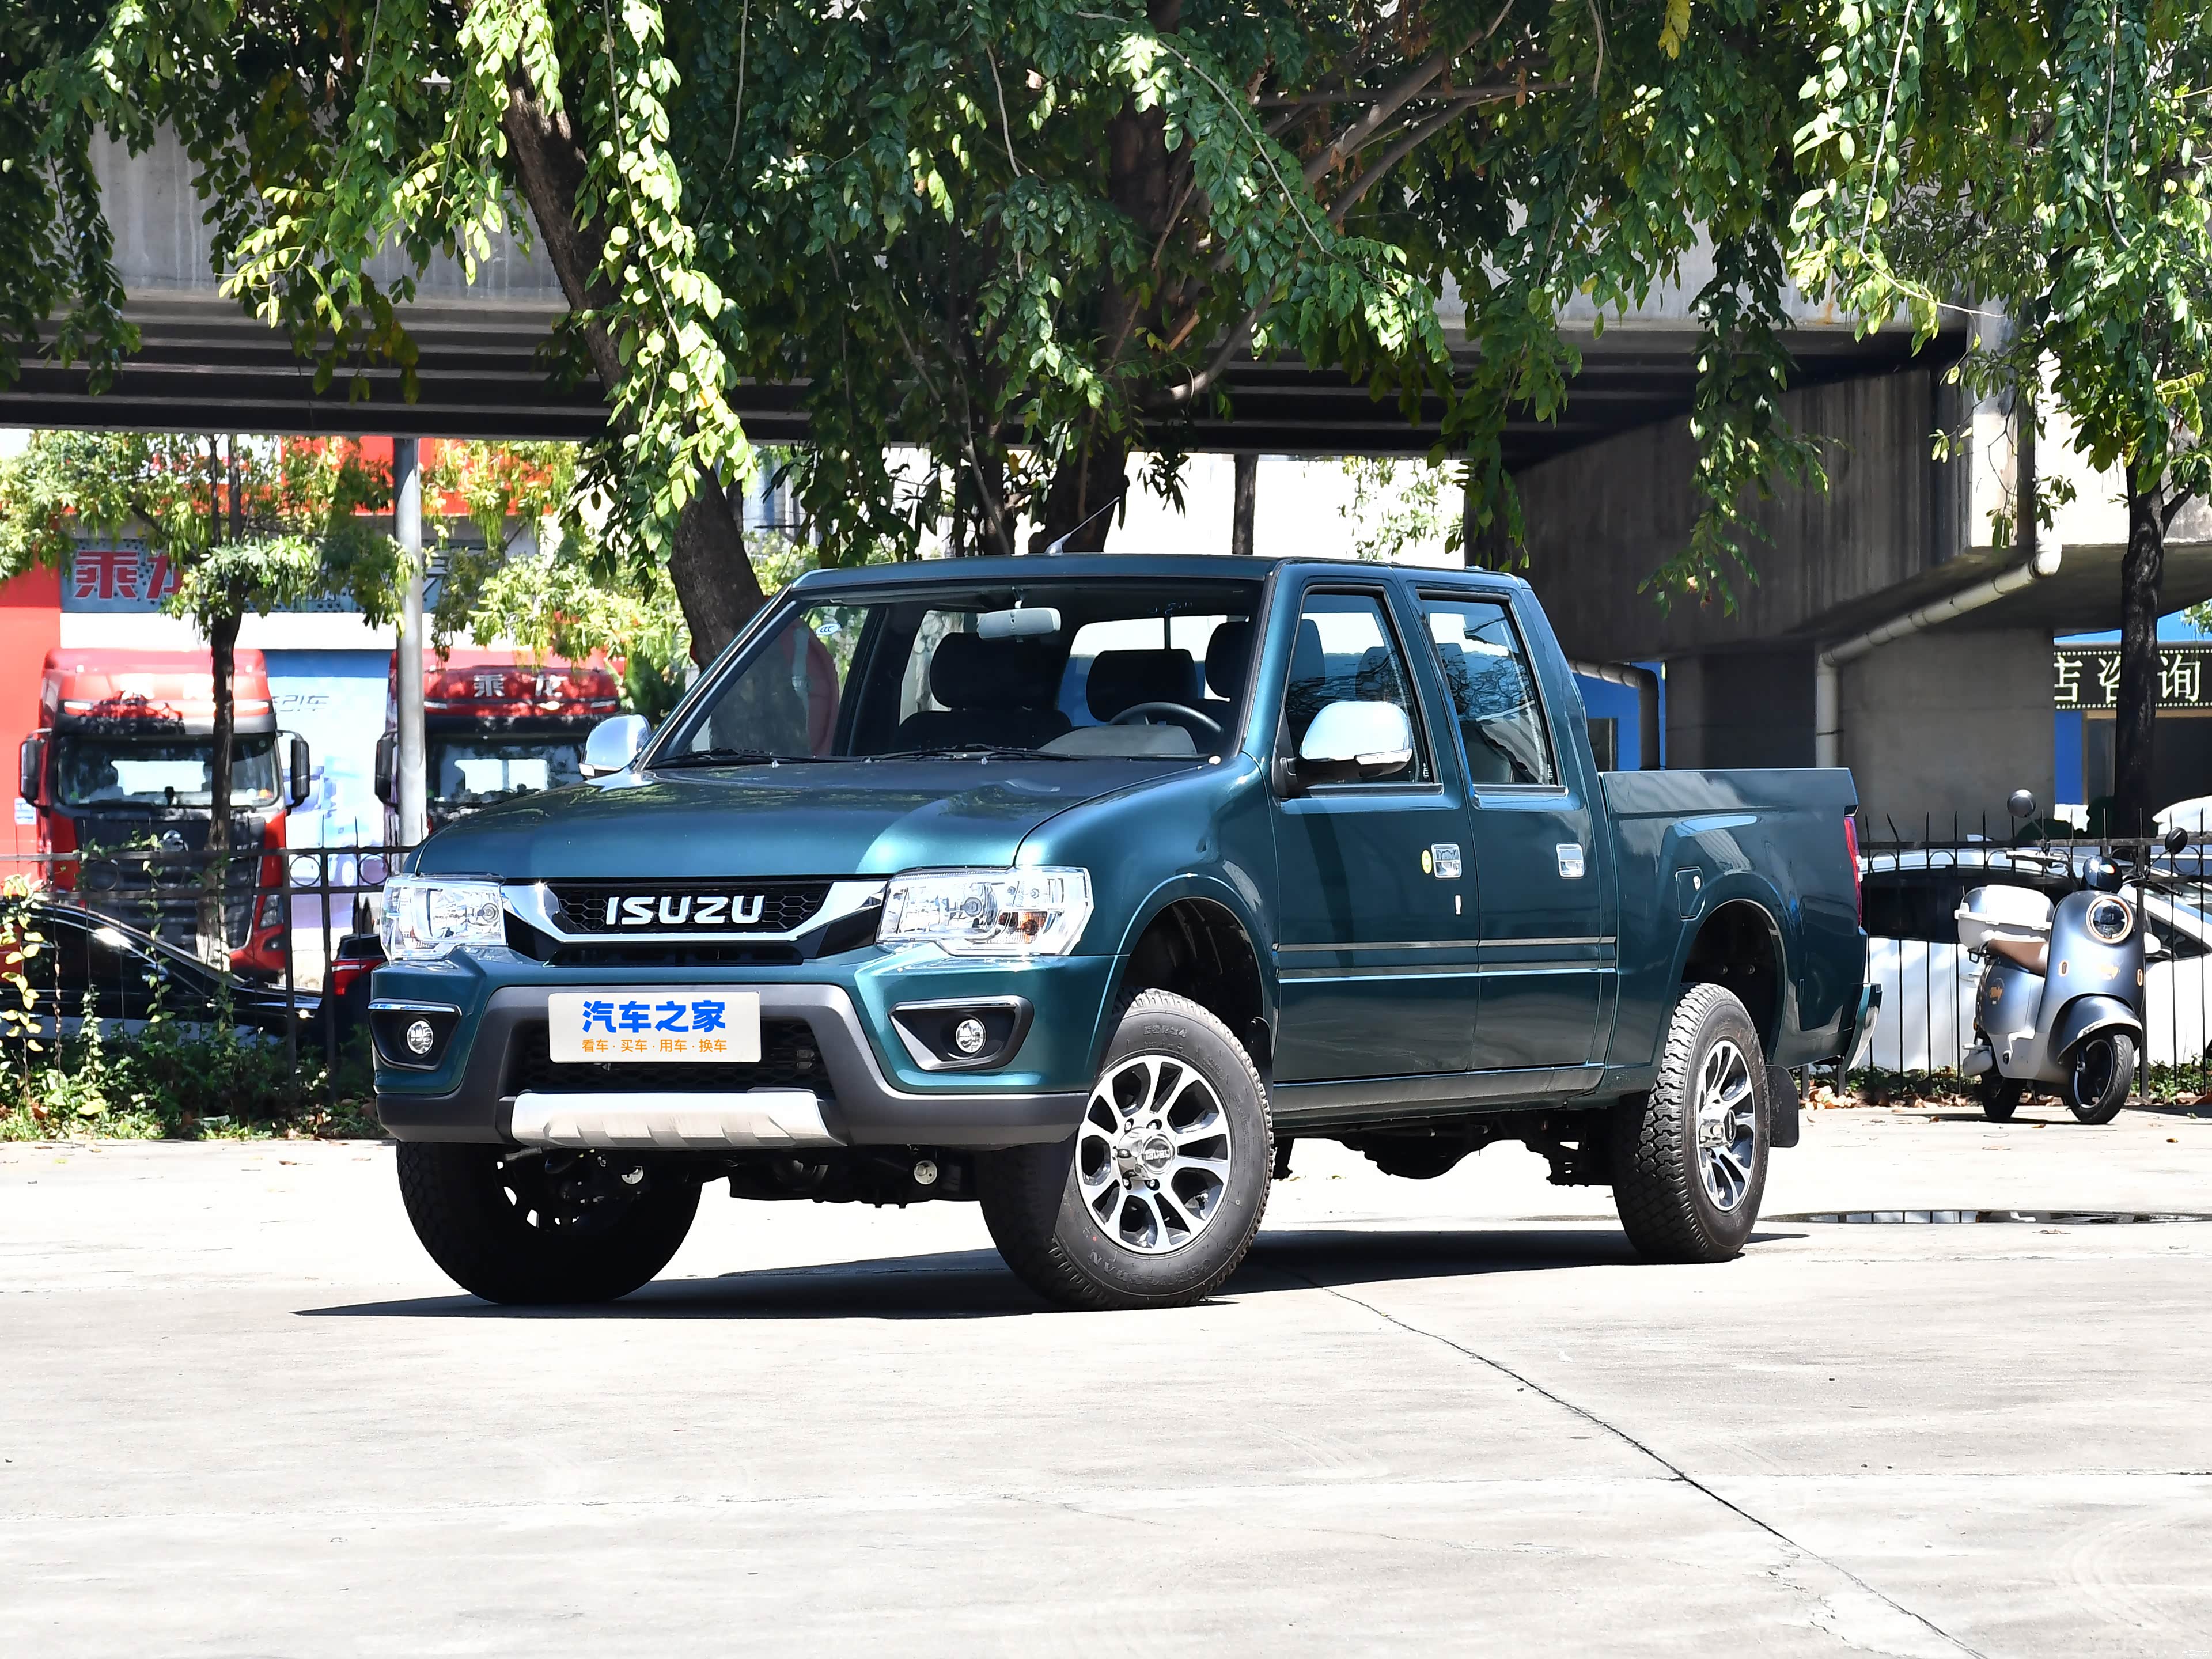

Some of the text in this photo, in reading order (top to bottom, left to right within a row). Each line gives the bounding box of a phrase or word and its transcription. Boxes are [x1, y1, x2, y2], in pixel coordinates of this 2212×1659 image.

[606, 895, 765, 925] ISUZU
[582, 1000, 726, 1033] 汽车之家
